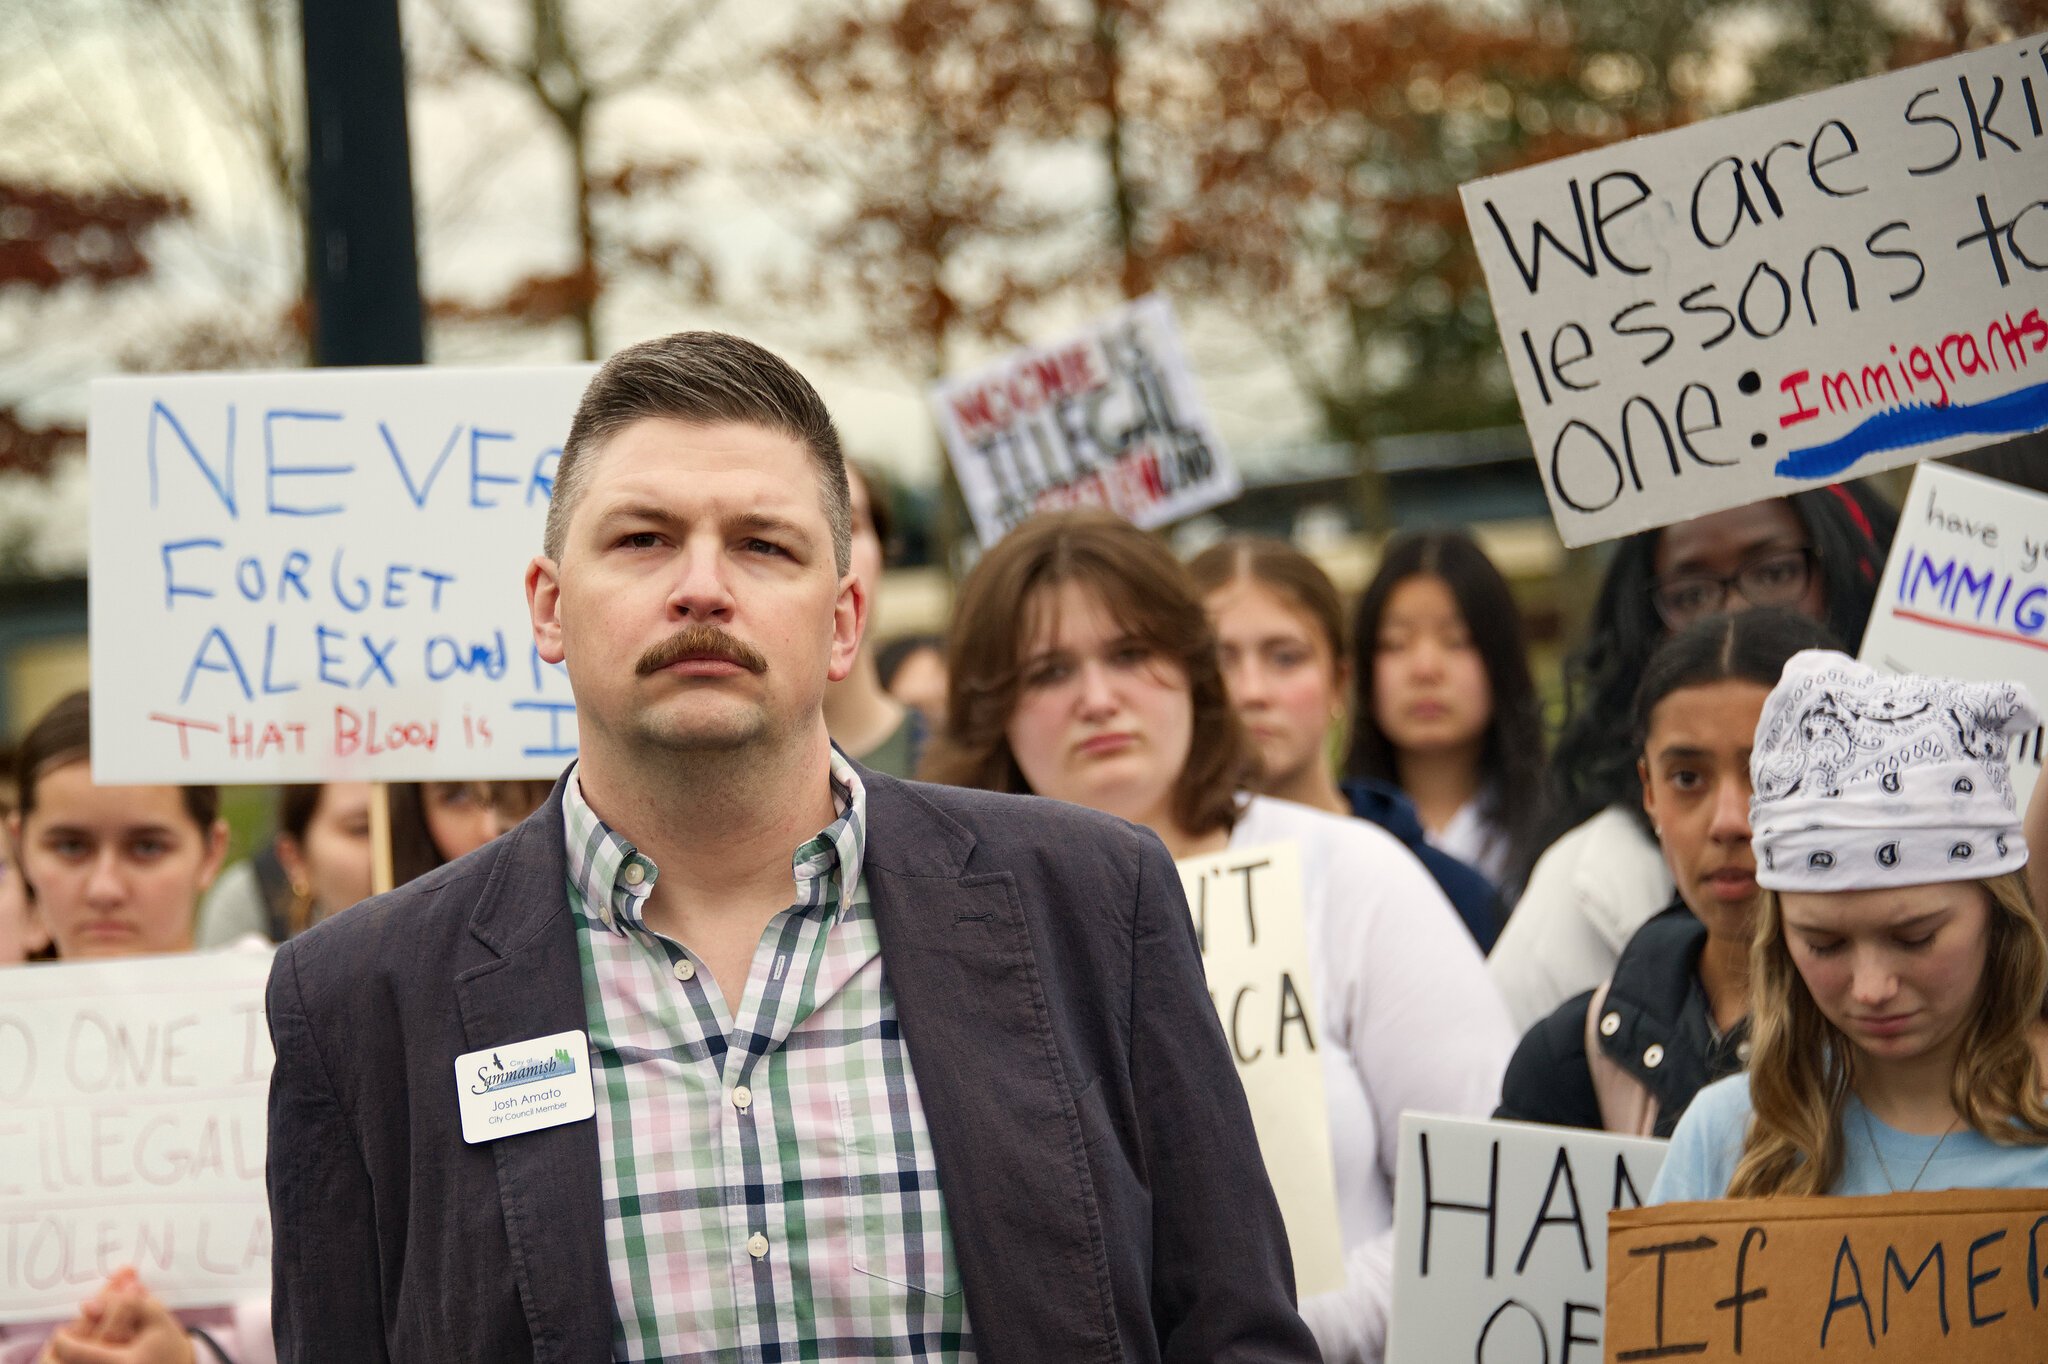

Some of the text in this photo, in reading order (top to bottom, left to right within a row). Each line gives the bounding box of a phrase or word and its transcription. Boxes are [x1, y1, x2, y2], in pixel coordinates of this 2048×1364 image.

[1690, 119, 1870, 249] are
[1521, 219, 1926, 406] lessons
[1778, 307, 2048, 429] Immigrants
[147, 397, 566, 520] NEVER
[1927, 487, 2000, 548] have
[161, 537, 457, 612] FORGET
[1899, 547, 2048, 635] IMMIG
[178, 622, 397, 704] ALEX
[148, 710, 306, 759] THAT
[65, 1008, 200, 1094] ONE
[471, 1056, 558, 1096] Sammamish
[488, 1101, 568, 1126] City Council Member
[492, 1087, 562, 1112] Josh Amato
